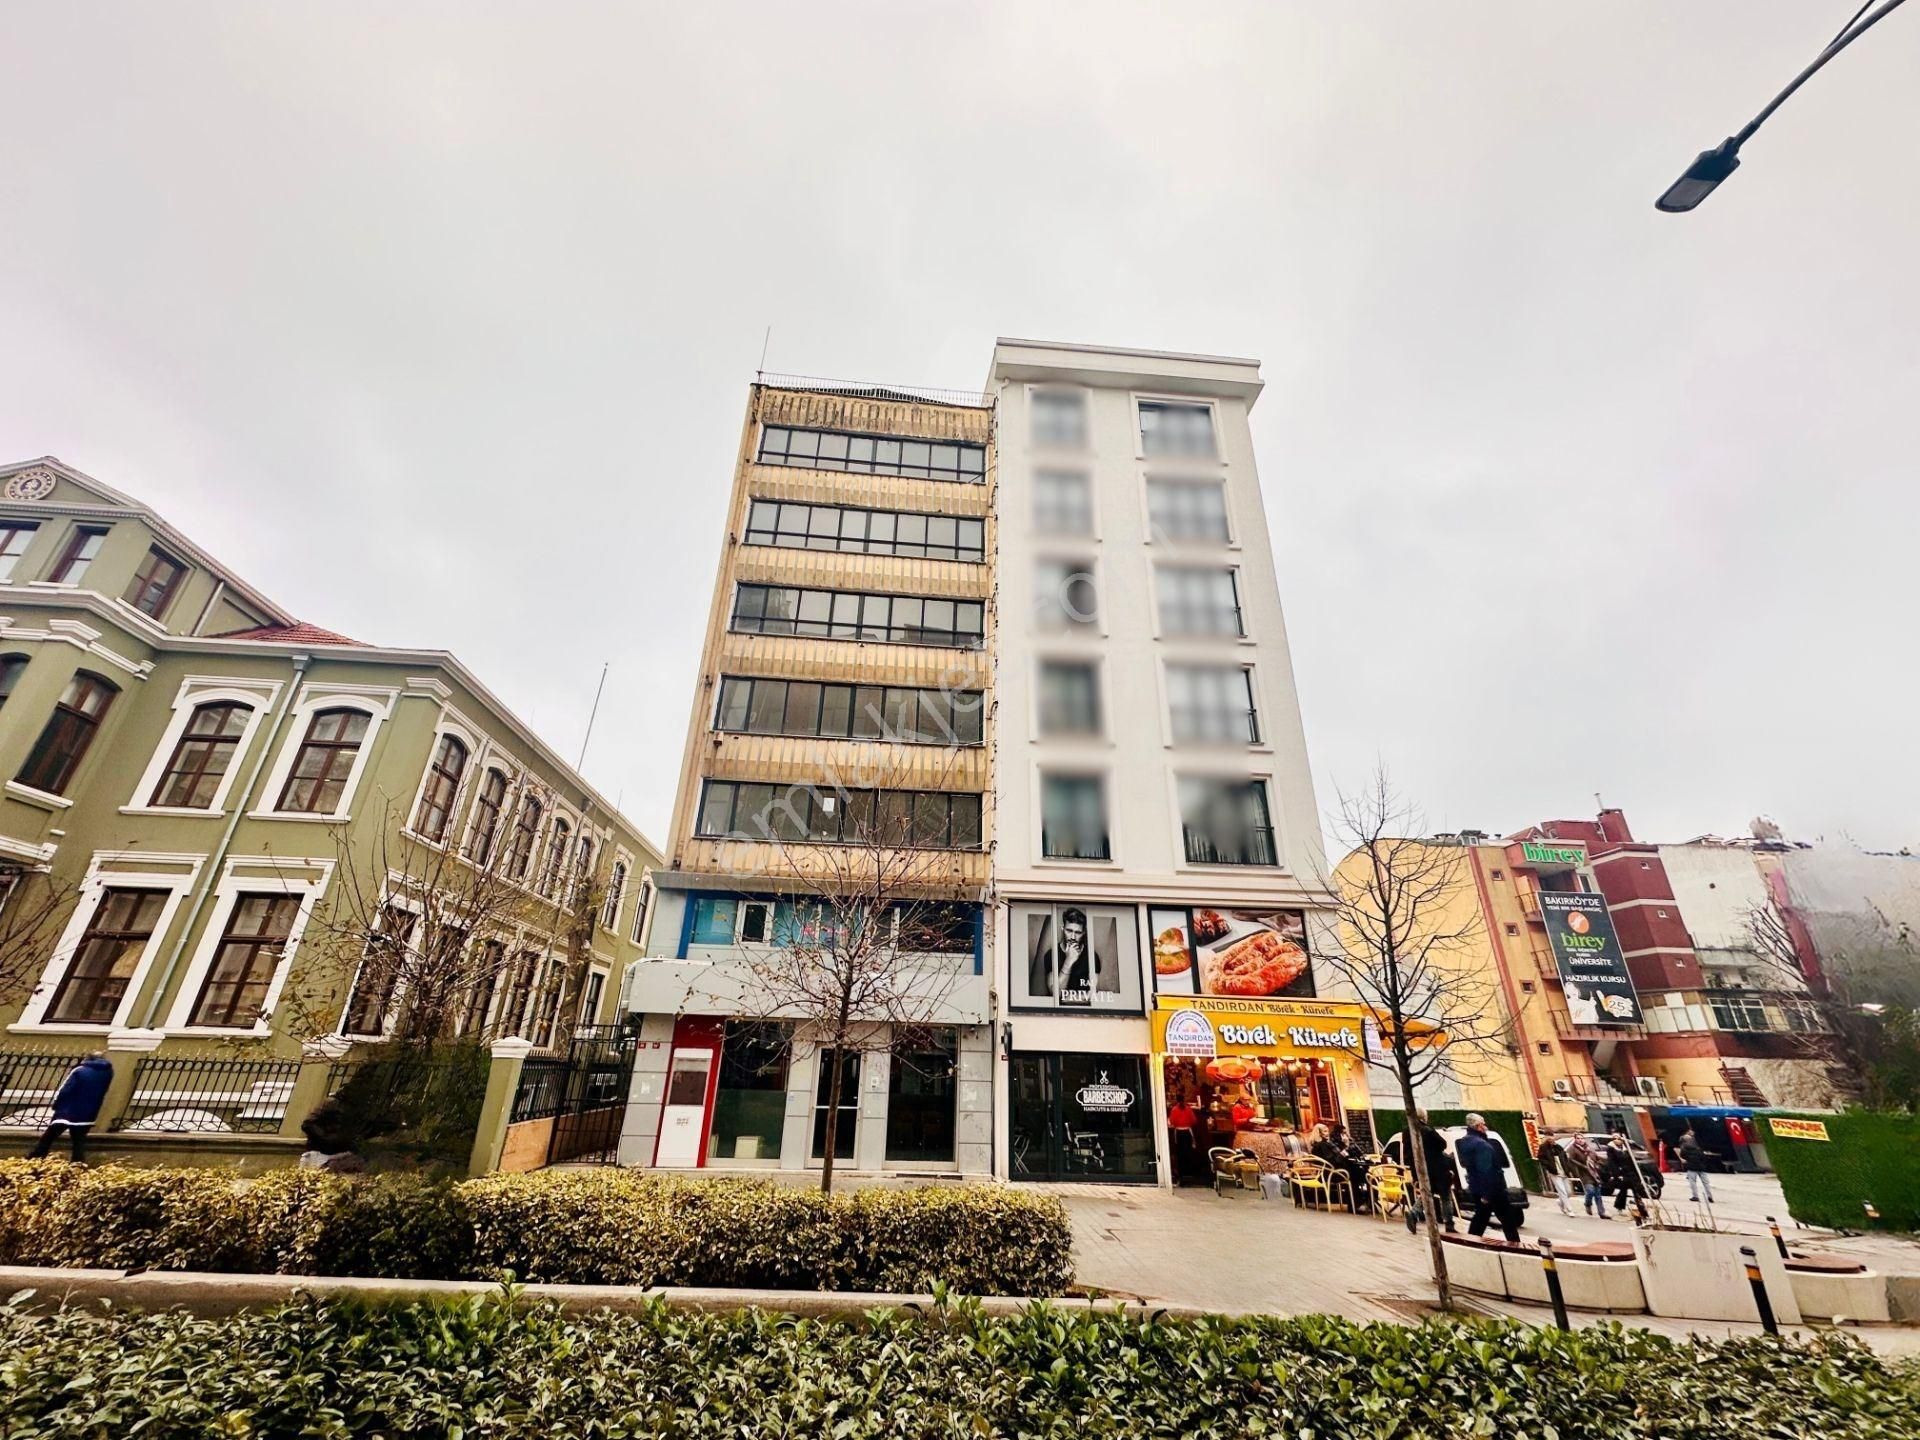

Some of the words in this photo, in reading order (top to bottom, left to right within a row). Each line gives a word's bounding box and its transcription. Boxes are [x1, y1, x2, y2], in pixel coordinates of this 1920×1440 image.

[1523, 842, 1584, 868] birey
[1560, 932, 1606, 950] birey
[1600, 975, 1626, 983] KURSU
[1061, 990, 1115, 1002] PRIVATE
[1191, 1000, 1264, 1013] TANDIRDAN
[1300, 1005, 1334, 1015] Künefe
[1609, 1000, 1625, 1011] 25
[1168, 1034, 1214, 1042] TANDIRDAN
[1288, 1026, 1359, 1048] Künefe
[1083, 1090, 1128, 1104] BARBERSHOP
